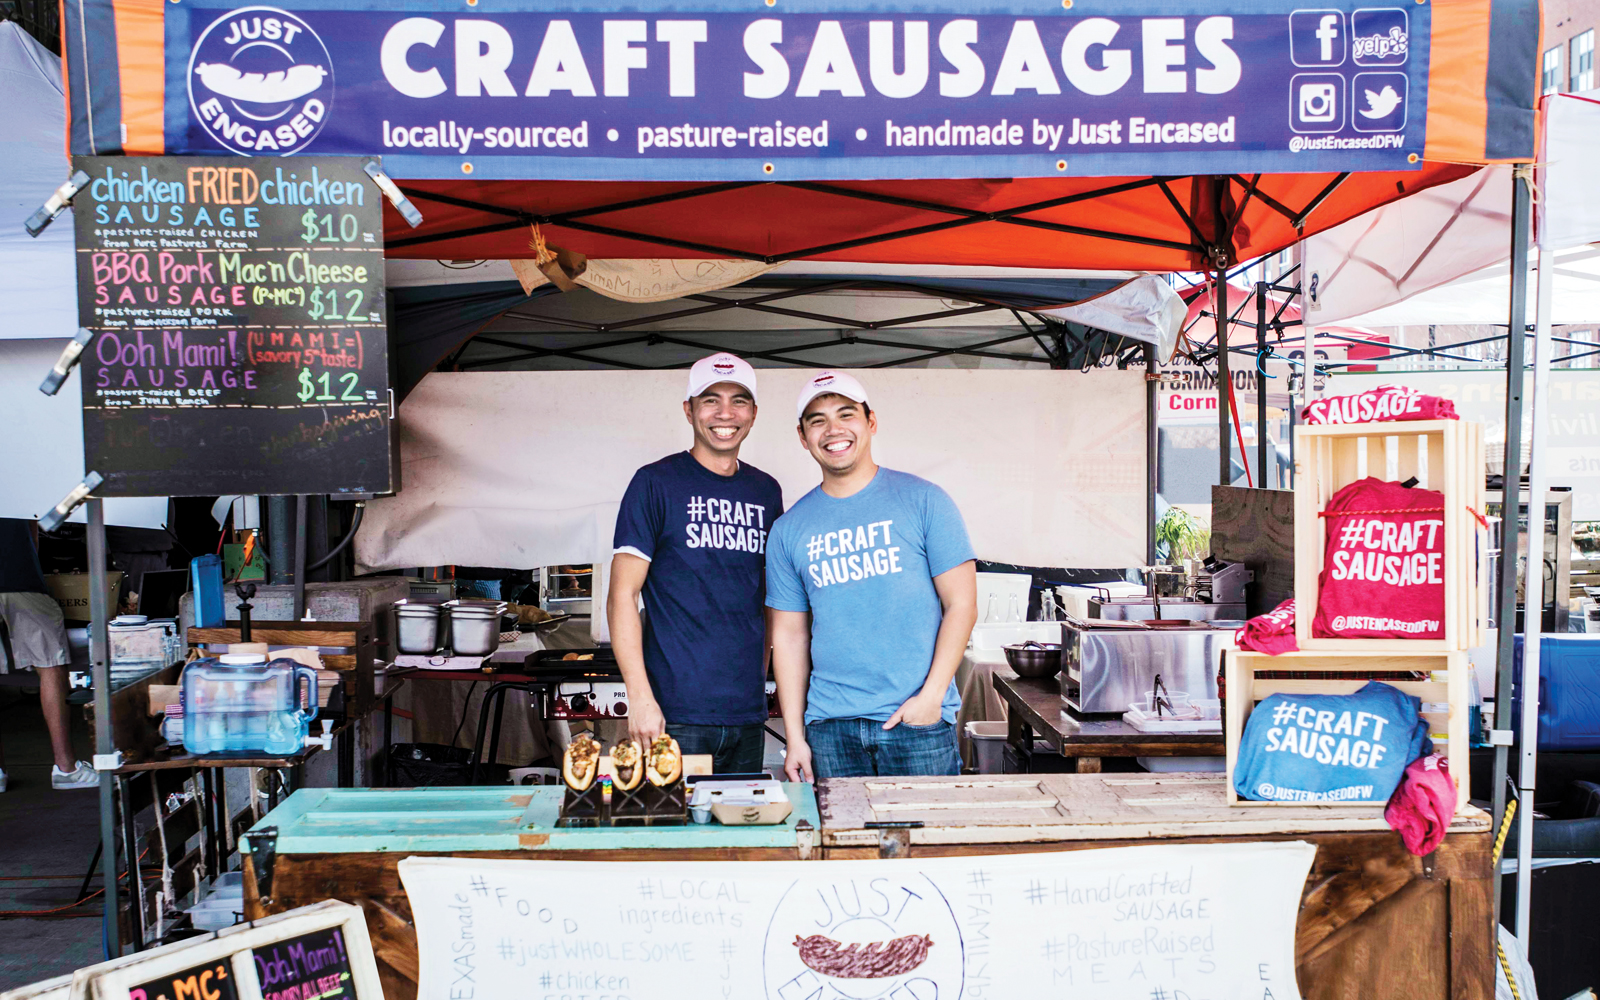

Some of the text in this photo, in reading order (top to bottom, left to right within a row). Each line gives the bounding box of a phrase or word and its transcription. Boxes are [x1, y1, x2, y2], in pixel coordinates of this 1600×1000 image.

[224, 17, 302, 45] JUST
[1354, 34, 1391, 57] yelp
[380, 16, 1242, 99] CRAFT SAUSAGES
[198, 97, 326, 150] ENCASED
[382, 116, 1235, 154] locally-sourced pasture-raised handmade by Just Encased
[1289, 135, 1405, 153] @JustEncasedDFW
[90, 166, 364, 206] chicken FRIED chicken
[96, 205, 261, 228] SAUSAGE
[300, 208, 358, 243] $10
[103, 240, 130, 248] from
[215, 239, 249, 248] Farm
[200, 229, 258, 238] CHICKEN
[91, 253, 152, 286] BBQ
[158, 252, 213, 284] Pork
[287, 251, 368, 284] Cheese
[96, 286, 246, 306] SAUSAGE
[196, 307, 233, 316] PORK
[308, 285, 369, 321] $12
[96, 330, 238, 367] Ooh Mami!
[320, 347, 357, 368] taste
[96, 368, 257, 390] SAUSAGE
[297, 367, 364, 402] $12
[1310, 393, 1422, 425] SAUSAGE
[687, 496, 765, 528] #CRAFT
[686, 523, 767, 554] SAUSAGE
[806, 519, 893, 562] #CRAFT
[1340, 519, 1443, 552] #CRAFT
[808, 546, 902, 589] SAUSAGE
[1332, 551, 1443, 586] SAUSAGE
[1332, 616, 1439, 633] @JUSTENCASEDDFW
[1272, 701, 1389, 741] #CRAFT
[1265, 727, 1387, 769] SAUSAGE
[1258, 783, 1373, 802] @JUSTENCASEDDFW
[638, 878, 751, 903] #LOCAL
[1024, 866, 1193, 905] #HandCrafted
[619, 904, 743, 934] ingredients
[815, 878, 923, 928] JUST
[1113, 899, 1211, 922] SAUSAGE
[287, 930, 346, 978] Mami!
[1041, 926, 1216, 961] #PastureRaised
[317, 972, 341, 989] BEEF
[539, 970, 630, 991] #chicken
[1052, 955, 1217, 986] MEATS
